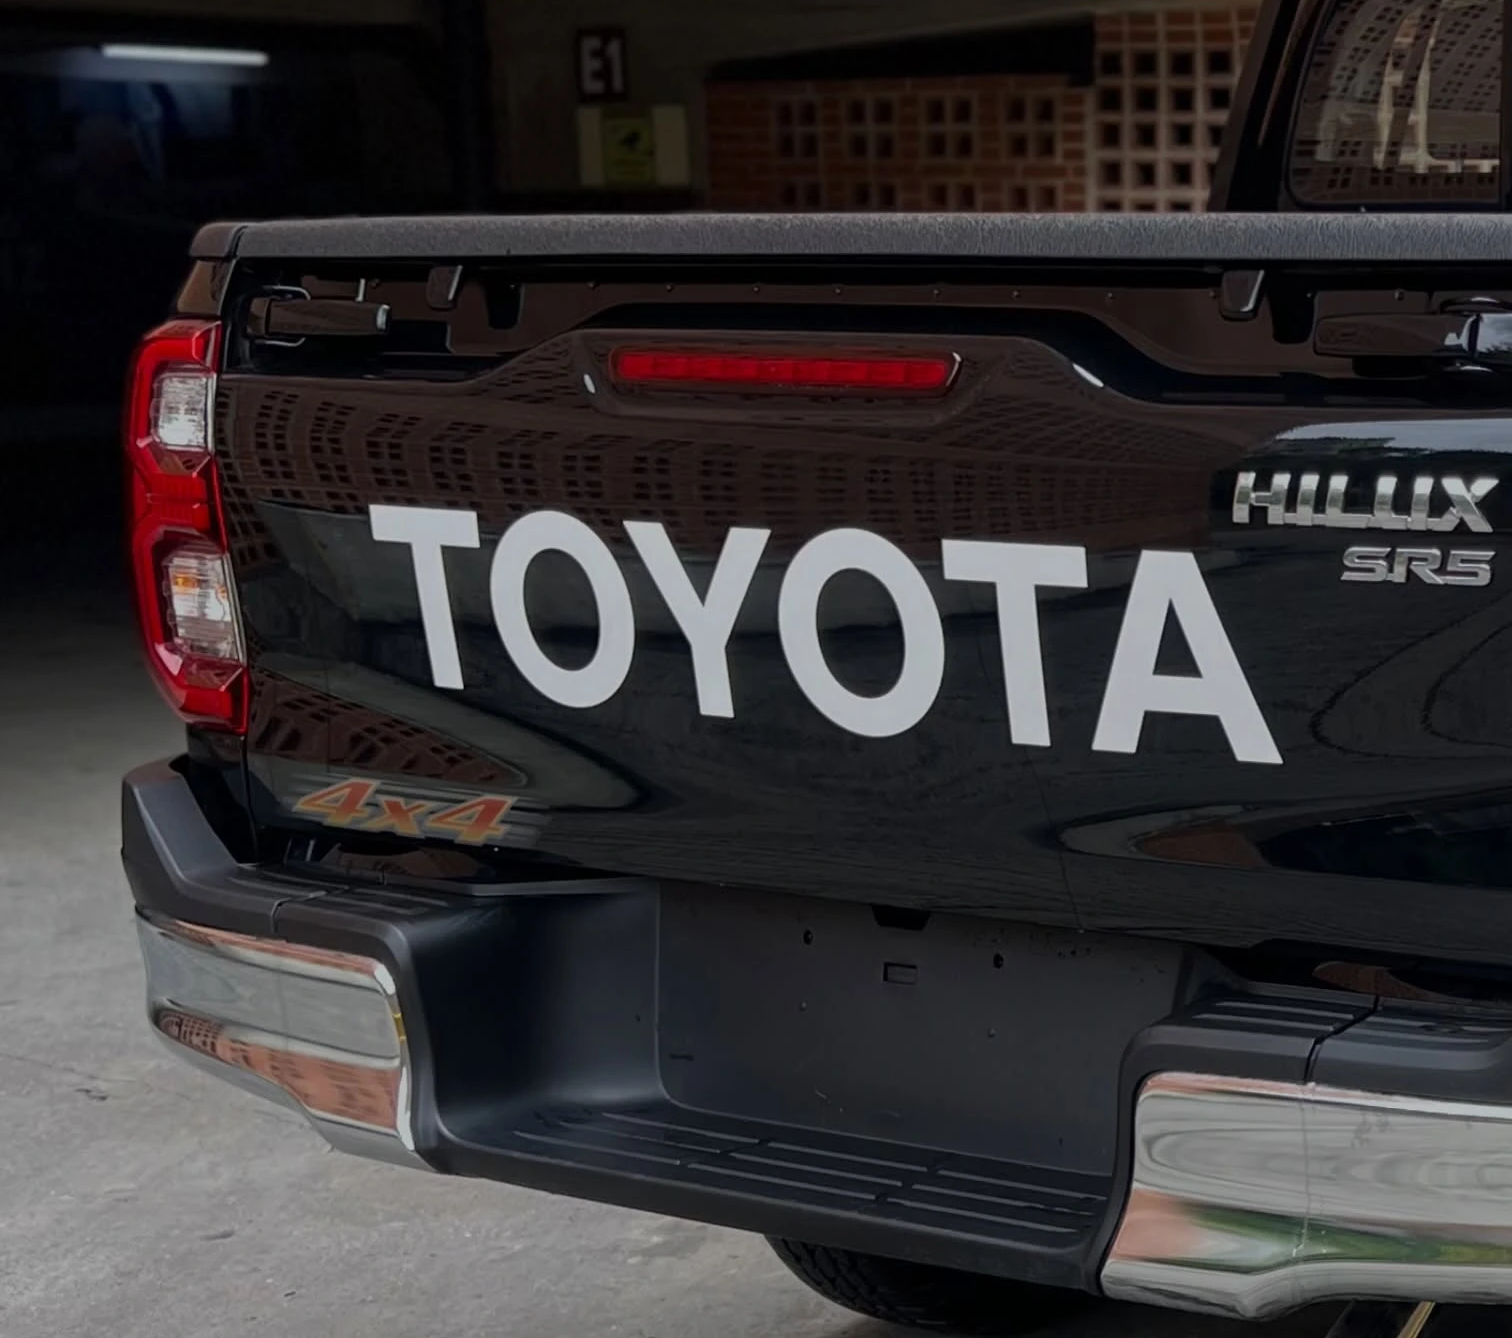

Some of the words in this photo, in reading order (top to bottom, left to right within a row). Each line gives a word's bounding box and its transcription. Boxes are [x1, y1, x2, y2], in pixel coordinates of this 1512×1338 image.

[579, 35, 625, 96] E1
[1231, 470, 1501, 534] HILUX
[1340, 545, 1497, 588] SR5
[368, 503, 1284, 765] TOYOTA
[291, 776, 519, 847] 4x4
